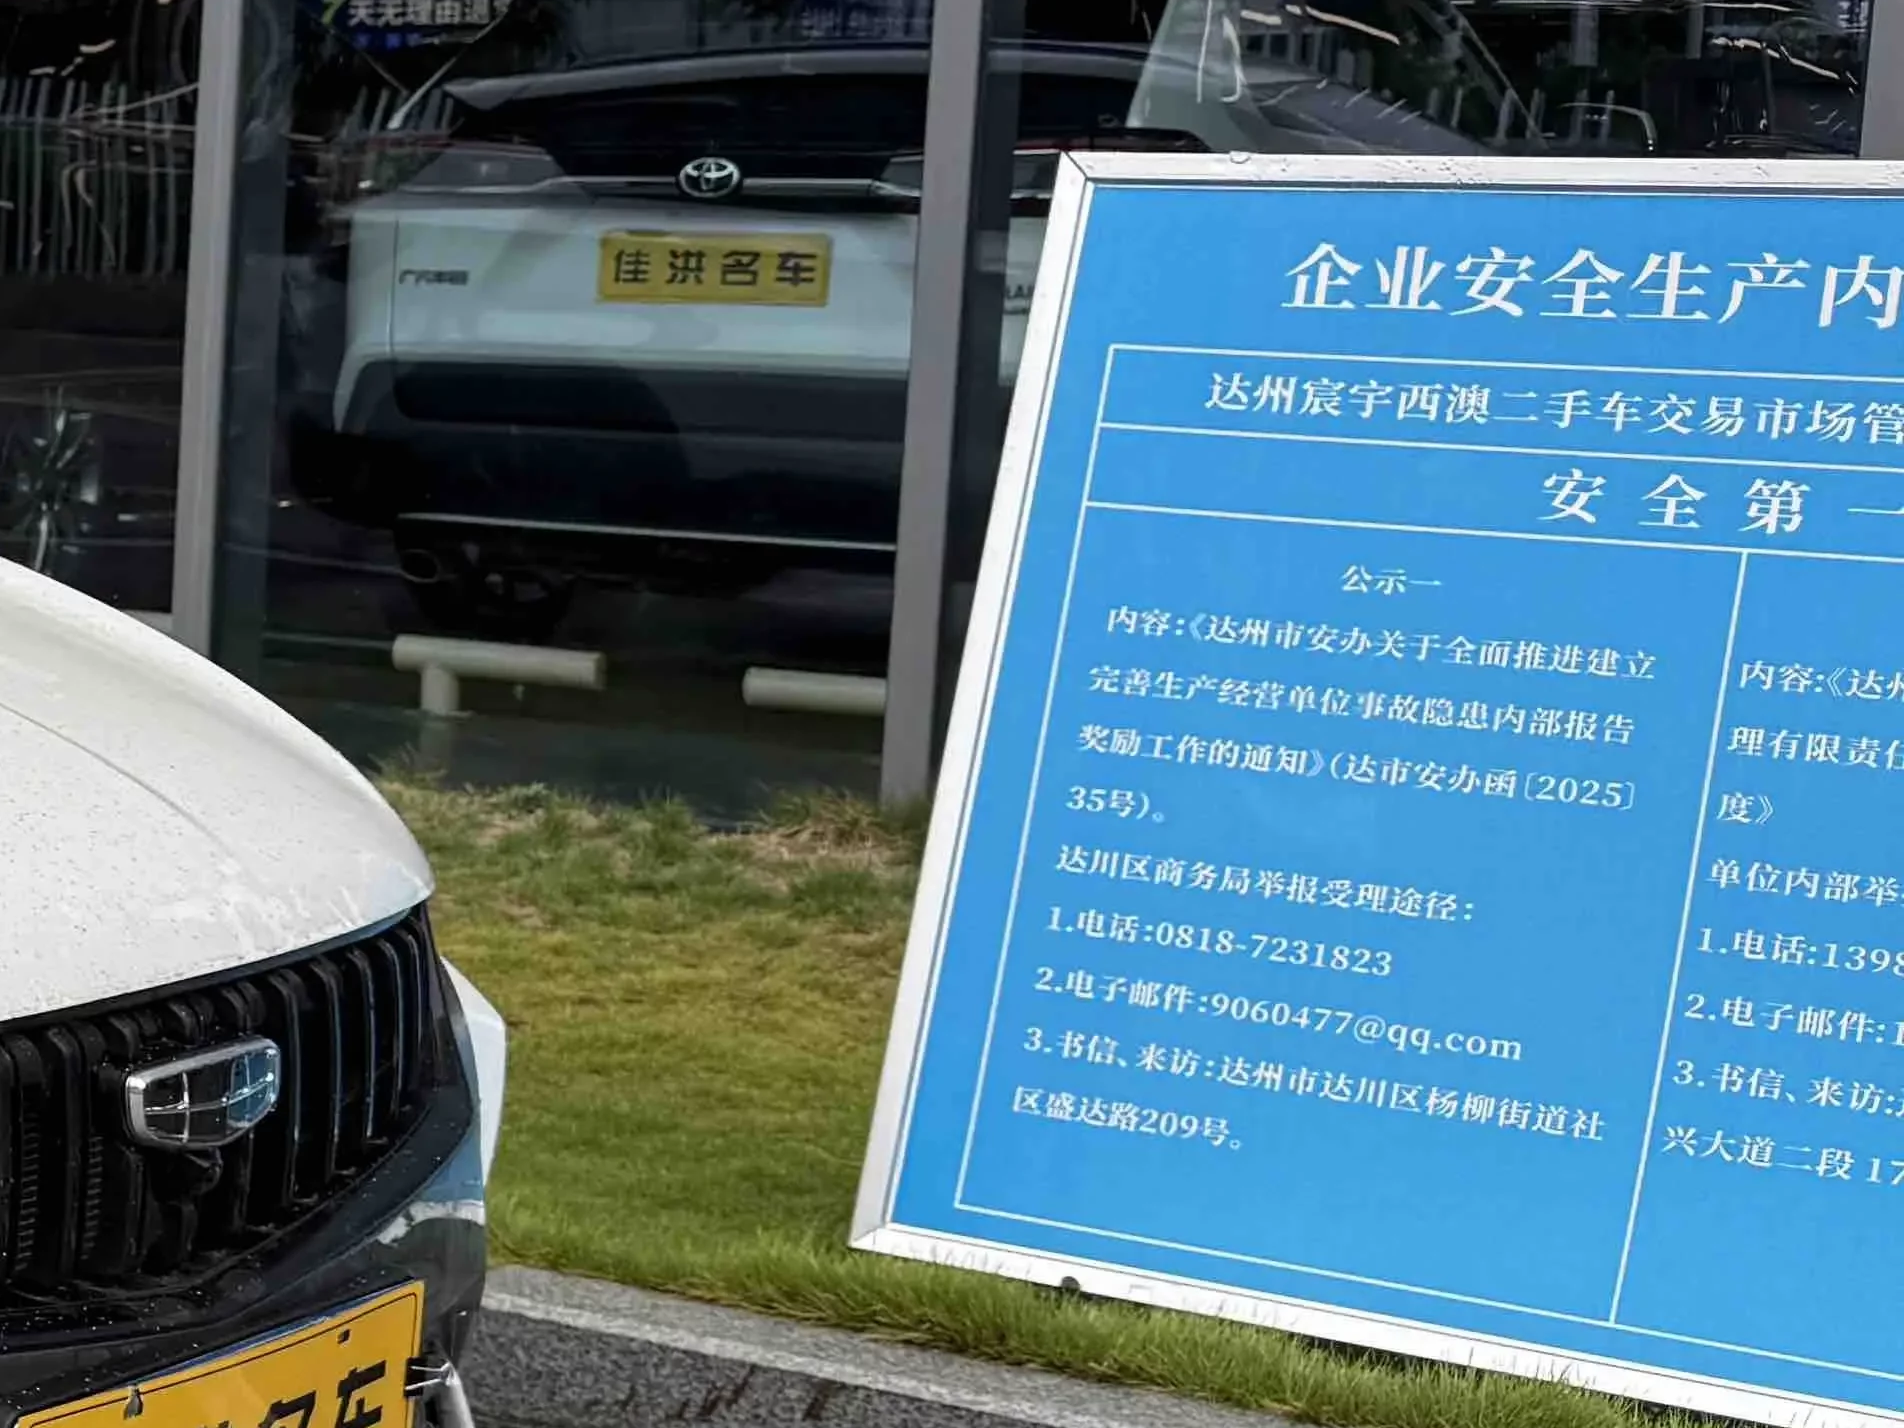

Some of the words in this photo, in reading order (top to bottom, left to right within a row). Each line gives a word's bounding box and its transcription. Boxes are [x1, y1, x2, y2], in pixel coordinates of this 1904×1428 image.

[613, 249, 817, 287] 佳洪名车
[1280, 241, 1904, 329] 企业安全生产内
[1204, 372, 1904, 446] 达州宸宇西澳二手车交易市场管
[1342, 565, 1442, 595] 公示一
[1107, 604, 1657, 679] 内容:《达州市安办关于全面推进建立
[1088, 665, 1635, 745] 完善生产经营单位事故隐患内部报告
[1056, 844, 1475, 922] 达川区商务局举报受理途径:
[1706, 857, 1904, 908] 单位内部举
[1045, 906, 1393, 977] 1.电话:0818-7231823
[1034, 967, 1522, 1061] 2.电子邮件:9060477@qq.com
[1012, 1085, 1242, 1150] 区盛达路209号。
[1022, 1027, 1607, 1142] 3.书信、来访:达州市达川区杨柳街道社
[1672, 1059, 1904, 1118] 3.书信、来访:
